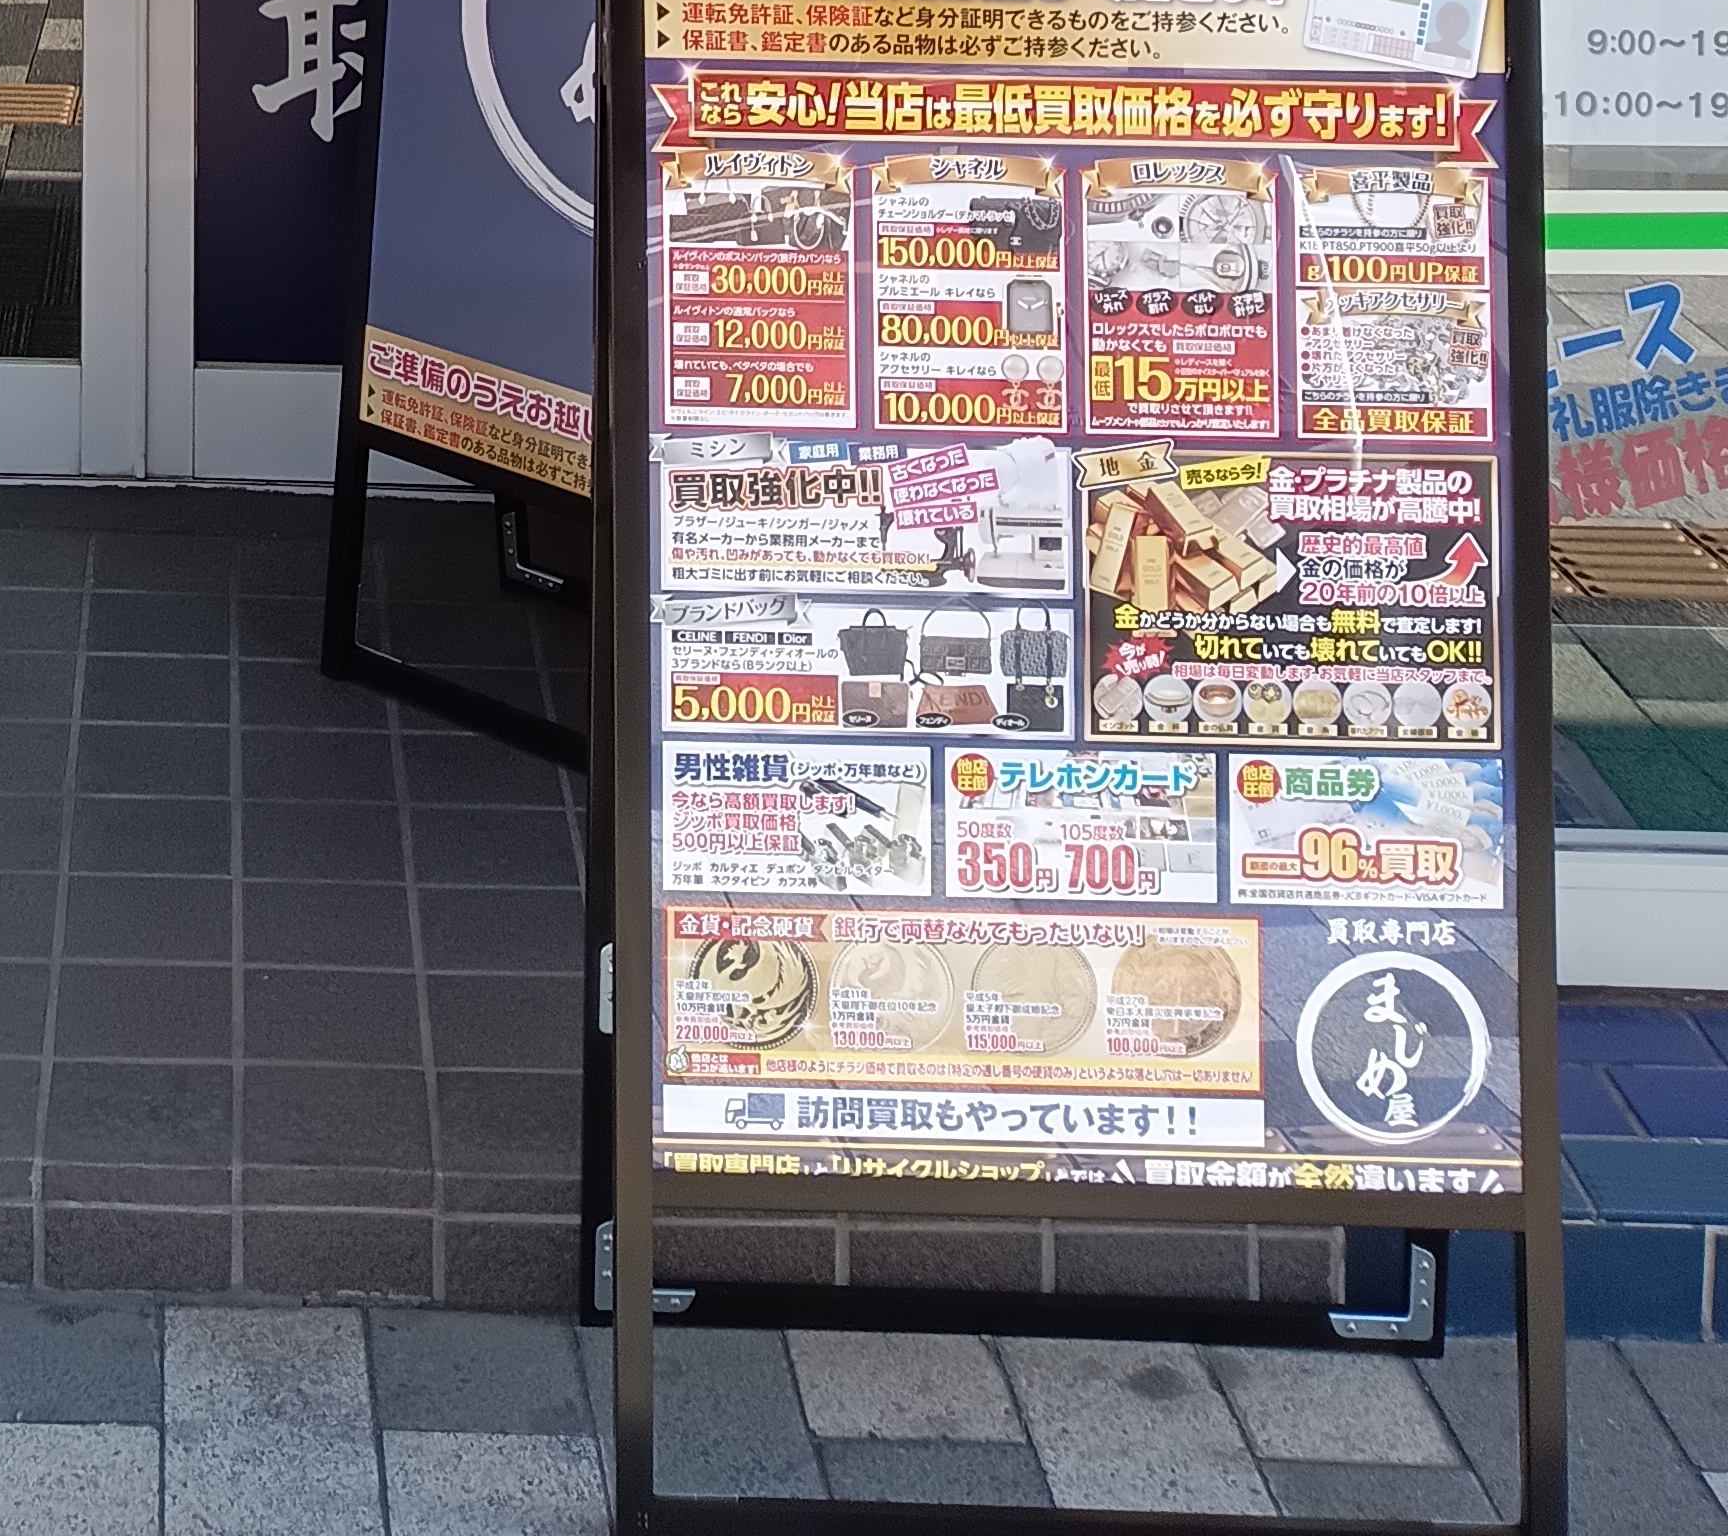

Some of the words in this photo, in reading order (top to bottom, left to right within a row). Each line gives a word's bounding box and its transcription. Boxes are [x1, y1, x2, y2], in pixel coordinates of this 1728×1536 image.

[681, 2, 1289, 35] 運転免許証、保険証など身分証明できるものをご持参ください。
[681, 29, 1161, 60] 保証書、鑑定書のある品物は必ずご持参ください。
[700, 82, 742, 102] これ
[700, 103, 743, 125] なら
[706, 153, 814, 177] ルイヴィトン
[929, 157, 1007, 179] シャネル
[1131, 162, 1226, 184] ロレックス
[1349, 170, 1433, 194] 喜平製品
[878, 195, 930, 208] シャネルの
[1301, 228, 1423, 239] こらのチラシを持参の方に限り
[711, 264, 822, 296] 30,000円
[878, 273, 930, 285] シャネルの
[944, 287, 996, 299] キレイなら
[1142, 290, 1172, 303] ガラス
[1187, 290, 1216, 303] ベルト
[713, 318, 822, 350] 12,000円
[1092, 322, 1268, 338] ロレックスでしたらボロボロでも
[1548, 282, 1696, 370] ース
[879, 351, 931, 363] シャネルの
[1092, 339, 1168, 353] 動かなくても
[879, 364, 941, 376] アクセサリー
[945, 365, 997, 377] キレイなら
[725, 374, 822, 405] 7,000円
[381, 388, 592, 471] 運転免許証、保険証など身分証明でき
[1313, 407, 1475, 434] 全品買取保証
[380, 409, 592, 493] 保証書、鑑定書のある品物は必ずご持
[689, 440, 747, 458] ミシン
[798, 443, 840, 459] 家庭用
[858, 445, 899, 460] 業務用
[890, 447, 966, 481] 古くなった
[1185, 461, 1262, 485] 売るなら今!
[893, 472, 997, 505] 使わなくなった
[896, 505, 976, 527] 壊れている
[1269, 494, 1481, 524] 買取相場が高騰中!
[671, 531, 881, 548] 有名メーカーから業務用メーカーまで
[1300, 534, 1425, 557] 歴史的最高値
[671, 568, 930, 588] 粗大ゴミに出す前にお気軽にご相談ください。
[1300, 558, 1407, 581] 金の価格が
[1299, 581, 1485, 608] 20年前の10倍以上
[1113, 603, 1483, 636] 金かどうか分からない場合も無料で査定します!
[677, 631, 718, 643] CELINE
[732, 632, 768, 643] FENDI
[783, 633, 808, 645] Dior
[674, 685, 811, 723] 5,000円
[957, 758, 988, 775] 他店
[999, 762, 1197, 793] テレホンカード
[1242, 764, 1274, 781] 他店
[957, 774, 988, 792] 圧倒
[1242, 781, 1274, 799] 圧倒
[1284, 767, 1376, 797] 商品券
[671, 791, 855, 813] 今なら高額買取します!
[671, 813, 796, 832] ジッポ買取価格
[957, 821, 1012, 839] 50度数
[1061, 823, 1125, 841] 105度数
[672, 832, 800, 853] 500円以上保証
[957, 839, 1054, 888] 350円
[1064, 843, 1156, 891] 700円
[672, 875, 703, 886] 万年筆
[711, 875, 770, 887] ネクタイピン
[678, 913, 816, 939] 金貨・記念硬貨
[834, 916, 1146, 946] 銀行で両替なんてもったいない!
[1326, 918, 1458, 947] 買取専門店
[1356, 972, 1430, 1128] まじめ屋
